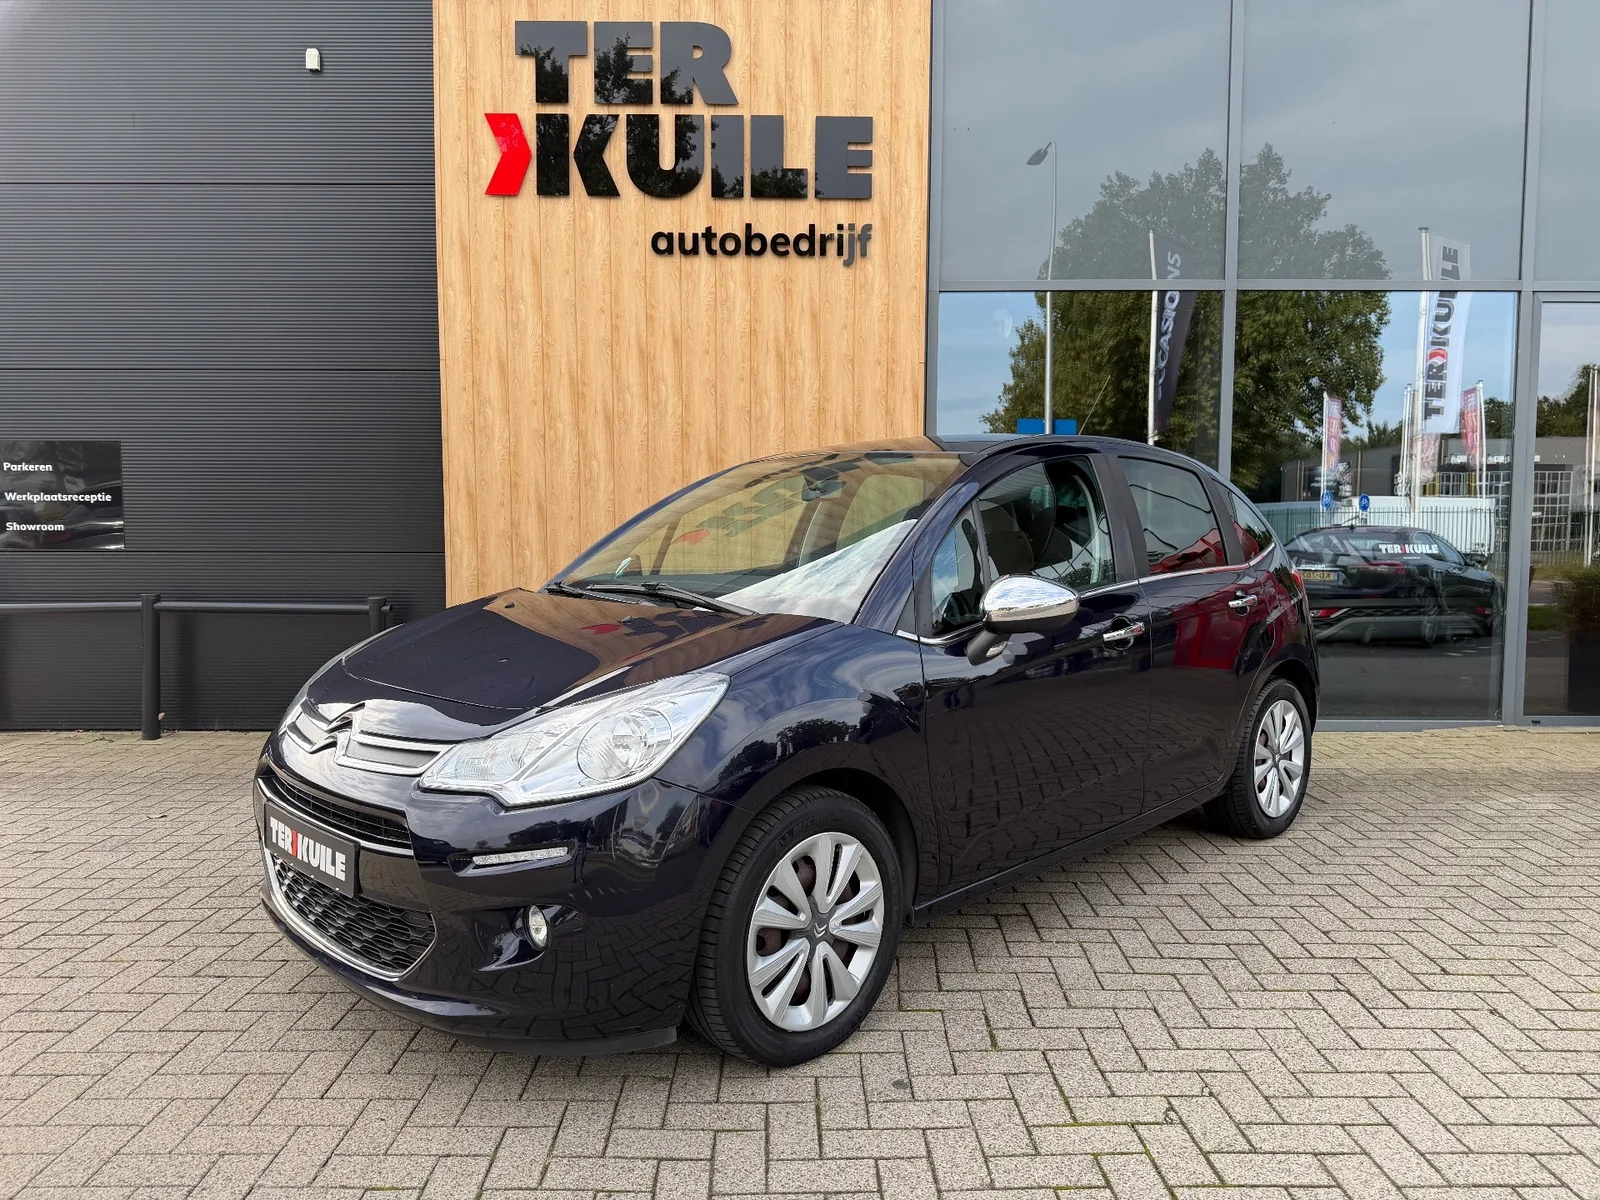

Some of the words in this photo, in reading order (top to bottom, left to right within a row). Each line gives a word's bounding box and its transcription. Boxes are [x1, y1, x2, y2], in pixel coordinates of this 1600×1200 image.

[515, 21, 739, 105] TER
[536, 113, 874, 200] KUILE
[651, 223, 873, 266] autobedrijf
[3, 462, 53, 472] Parkeren
[4, 492, 112, 504] Werkplaatsreceptie
[5, 522, 65, 532] Showroom
[1379, 544, 1401, 554] TER
[1405, 544, 1439, 554] KUILE
[270, 816, 293, 854] TER
[297, 833, 346, 881] KUILE
